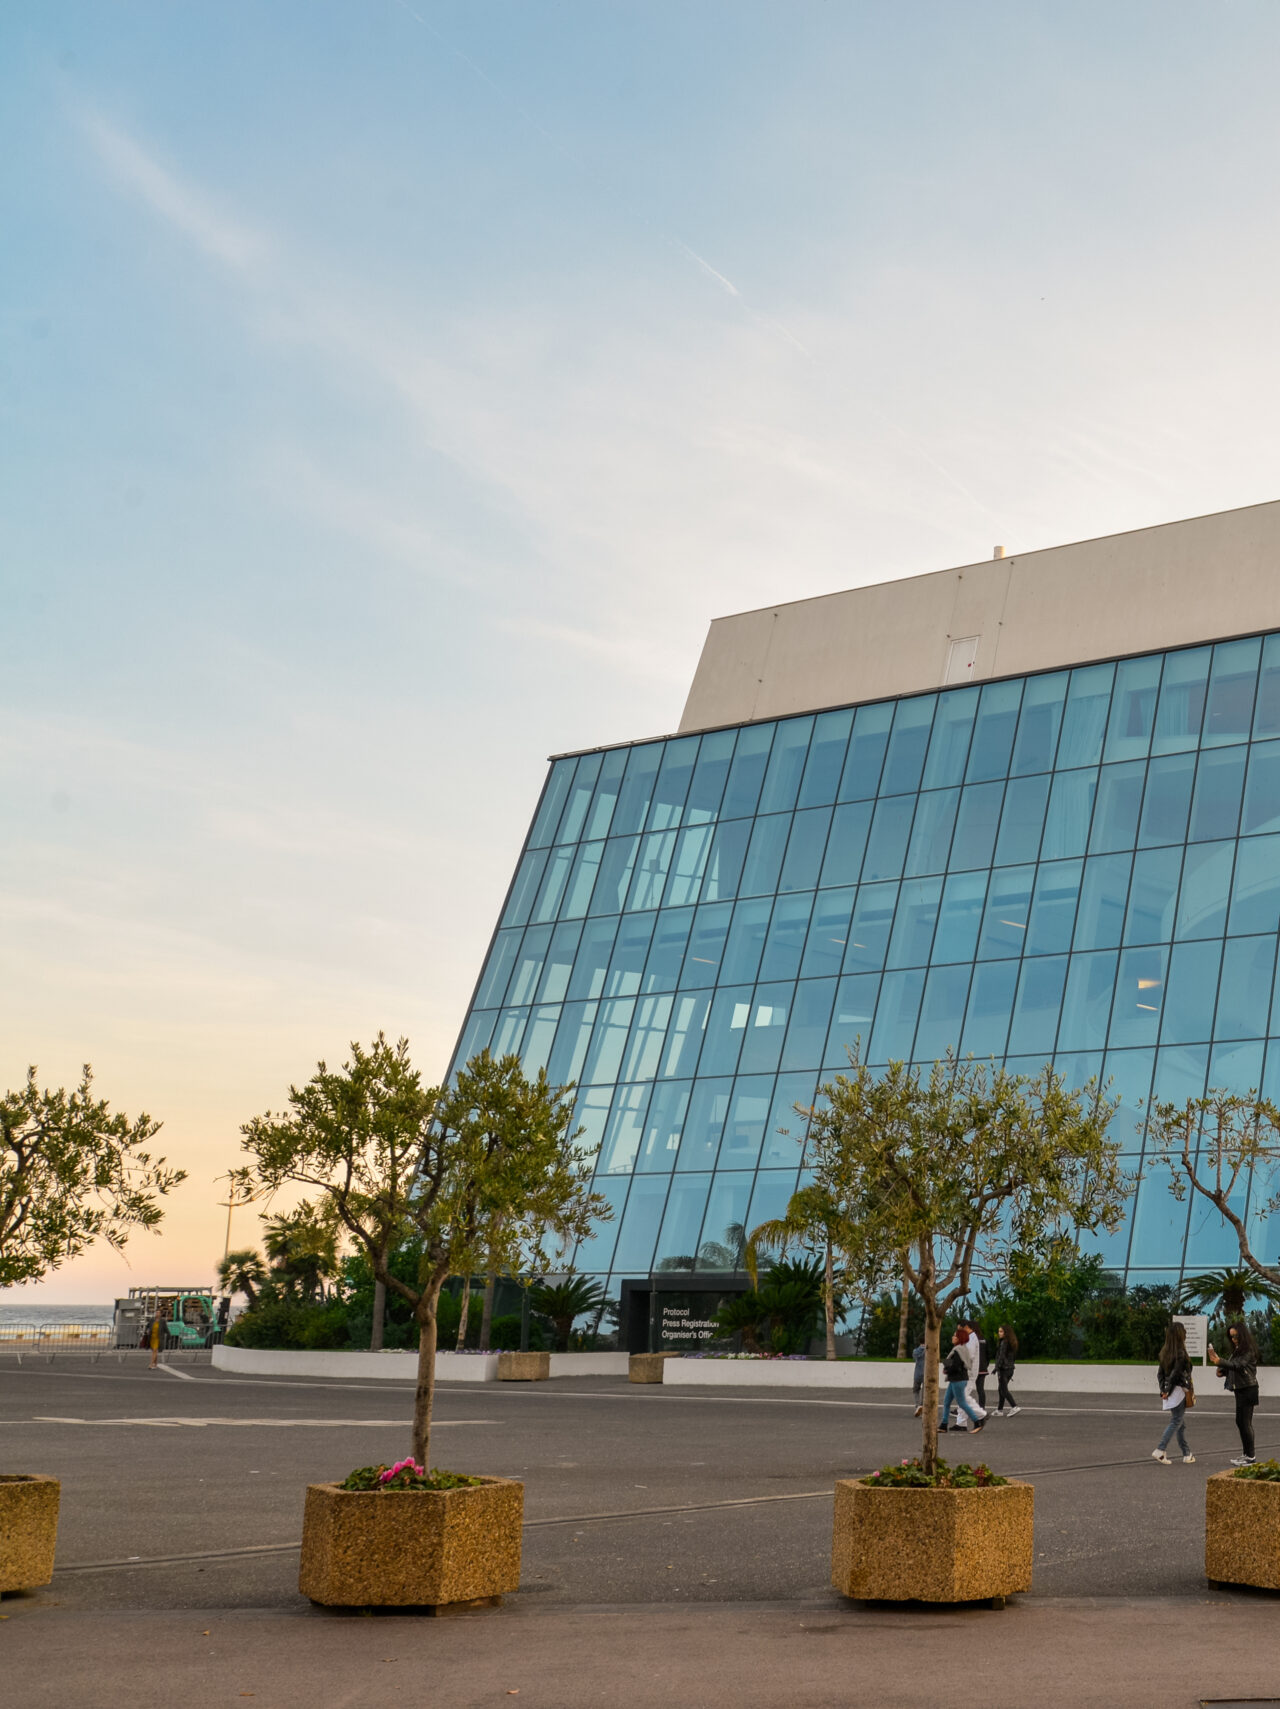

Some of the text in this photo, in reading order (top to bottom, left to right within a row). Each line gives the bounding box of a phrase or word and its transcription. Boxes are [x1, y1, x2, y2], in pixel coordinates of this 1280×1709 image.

[663, 1307, 690, 1316] Protocol
[662, 1319, 720, 1329] Press Registration
[661, 1330, 697, 1340] Organiser's
